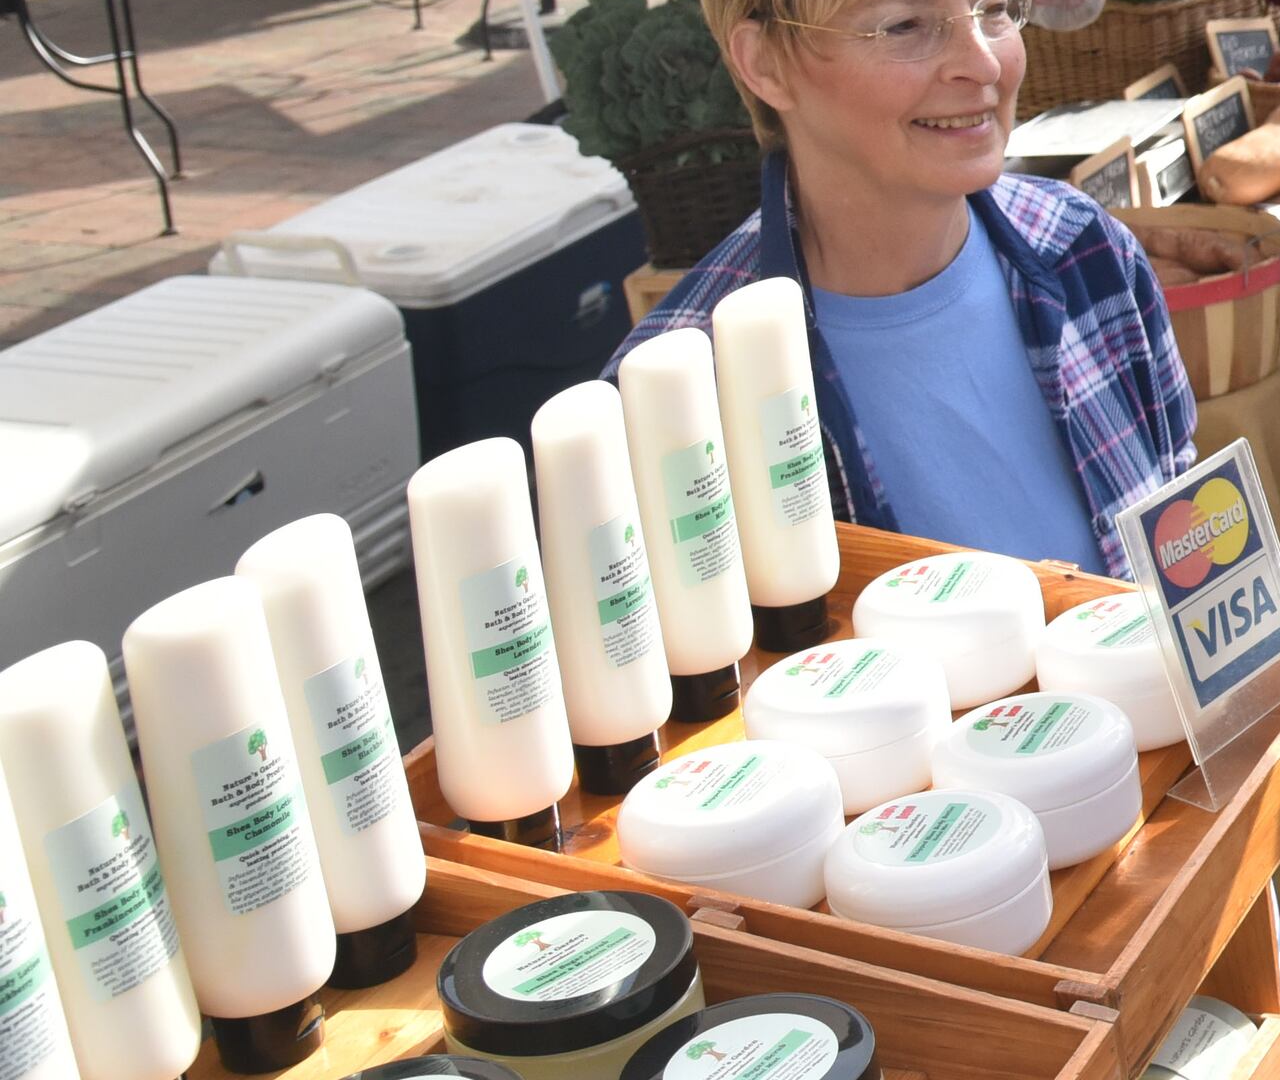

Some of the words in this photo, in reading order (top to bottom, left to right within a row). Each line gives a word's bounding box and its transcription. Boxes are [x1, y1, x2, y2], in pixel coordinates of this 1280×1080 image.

[1159, 498, 1245, 570] MasterCard
[485, 619, 502, 629] Bath
[512, 609, 527, 619] Body
[495, 601, 522, 616] Nature's
[1188, 575, 1278, 658] VISA
[495, 645, 514, 656] Shea
[517, 635, 532, 648] Body
[328, 716, 346, 729] Bath
[341, 745, 361, 759] Shea
[223, 771, 258, 791] Nature's
[211, 793, 234, 806] Bath
[236, 788, 243, 796] &
[245, 778, 265, 792] Body
[226, 824, 250, 838] Shea
[253, 809, 275, 826] Body
[244, 811, 290, 841] Chamomile
[910, 841, 929, 857] Whipped
[924, 830, 936, 840] Shea
[933, 820, 946, 829] Body
[941, 806, 956, 818] Butter
[88, 852, 124, 876] Nature's
[239, 849, 259, 862] Quick
[246, 854, 270, 867] lasting
[77, 876, 100, 893] Bath
[94, 904, 119, 921] Shea
[120, 889, 140, 906] Body
[517, 950, 553, 970] Nature's
[552, 933, 584, 950] Garden
[536, 969, 557, 980] Shea
[558, 955, 584, 968] Sugar
[583, 940, 609, 954] Scrub
[731, 1039, 756, 1059] Garden
[764, 1043, 786, 1060] Scrub
